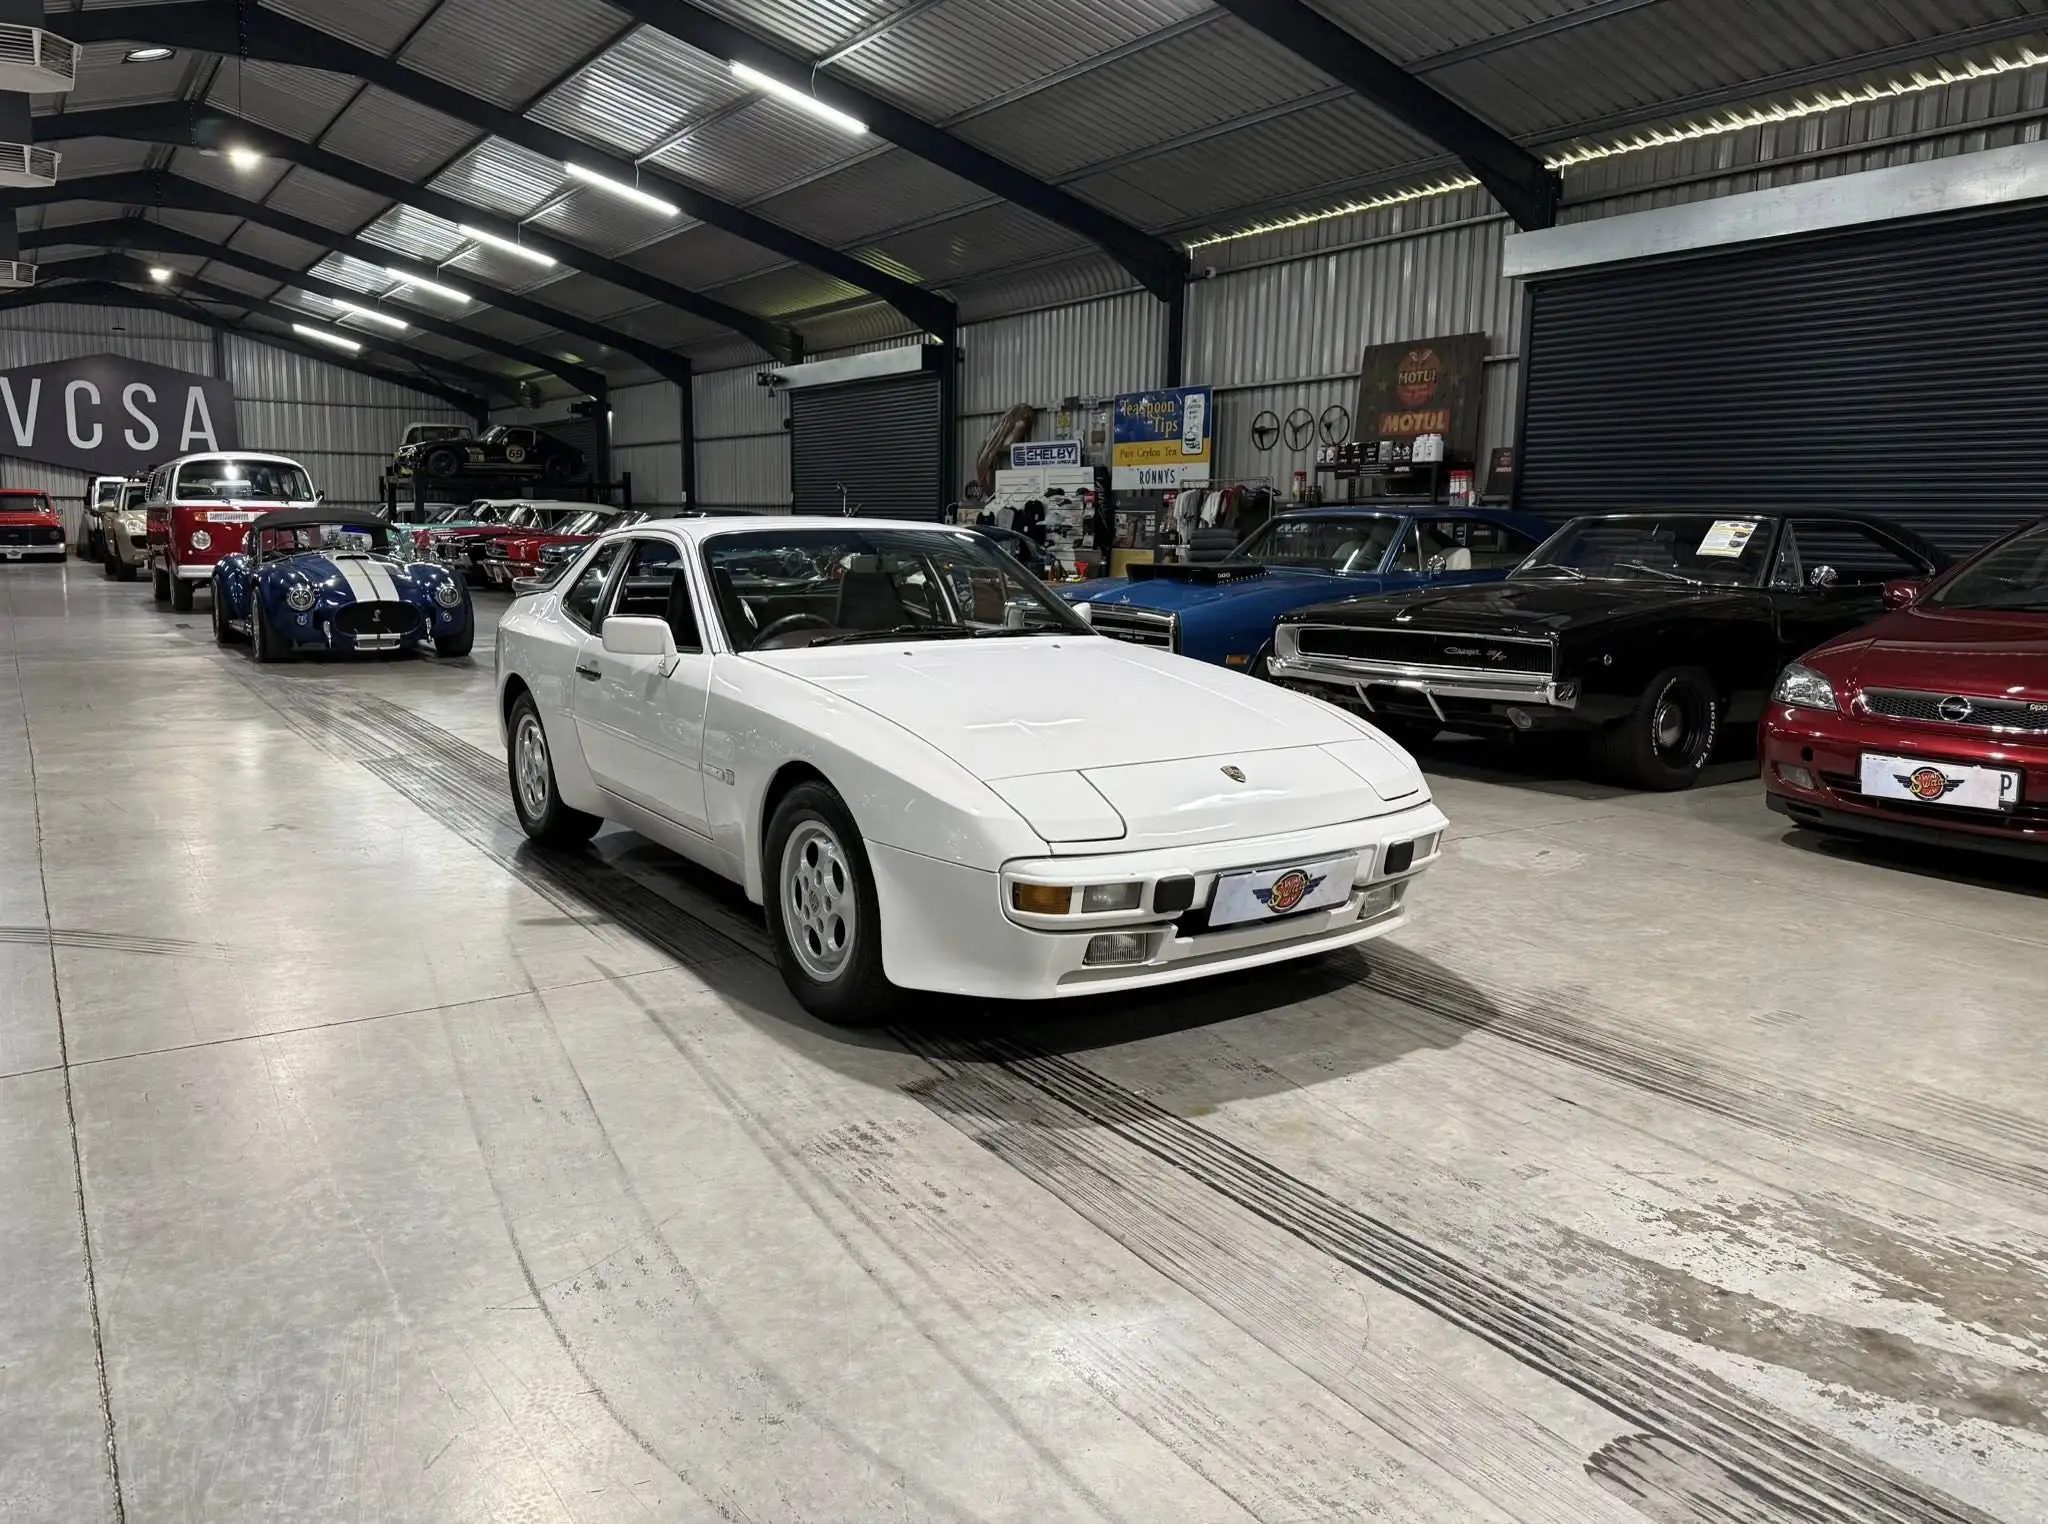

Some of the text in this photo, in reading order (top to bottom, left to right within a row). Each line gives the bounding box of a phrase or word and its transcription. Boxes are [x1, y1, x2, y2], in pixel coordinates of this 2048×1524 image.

[0, 377, 219, 452] VCSA
[1120, 398, 1174, 419] Teaspoon
[1153, 415, 1178, 437] Tips
[1382, 411, 1445, 432] MOTUL
[1026, 447, 1075, 460] SHELBY
[1165, 446, 1177, 456] Tea
[2000, 774, 2012, 796] P
